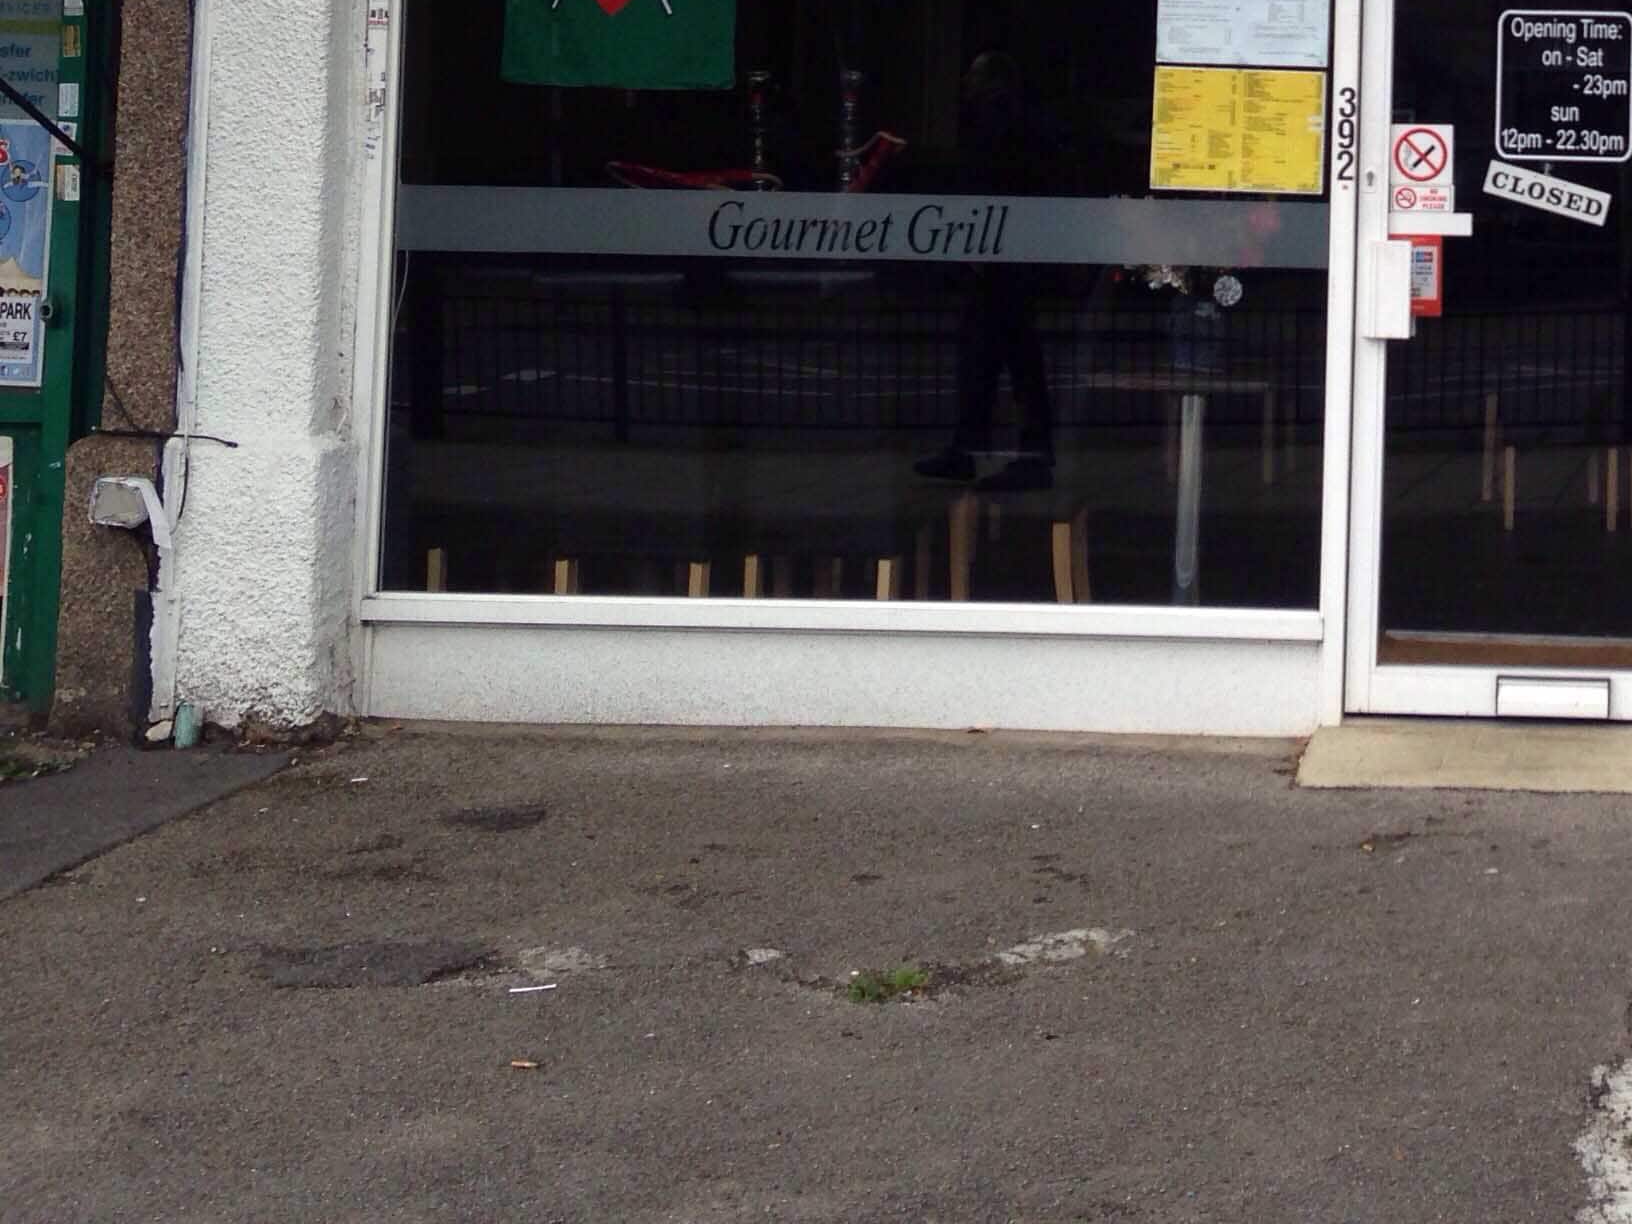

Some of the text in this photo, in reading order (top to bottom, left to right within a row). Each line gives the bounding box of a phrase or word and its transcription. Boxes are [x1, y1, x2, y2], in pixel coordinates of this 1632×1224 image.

[1511, 17, 1624, 43] Opening Time:
[1541, 49, 1562, 66] on
[1576, 46, 1604, 67] Sat
[1583, 75, 1628, 100] 23pm
[1551, 105, 1580, 122] sun
[1337, 87, 1356, 181] 392
[1502, 128, 1542, 152] 12pm
[1556, 129, 1625, 155] 22.30pm
[1492, 171, 1603, 216] CLOSED
[708, 201, 1009, 255] Gourmet Grill
